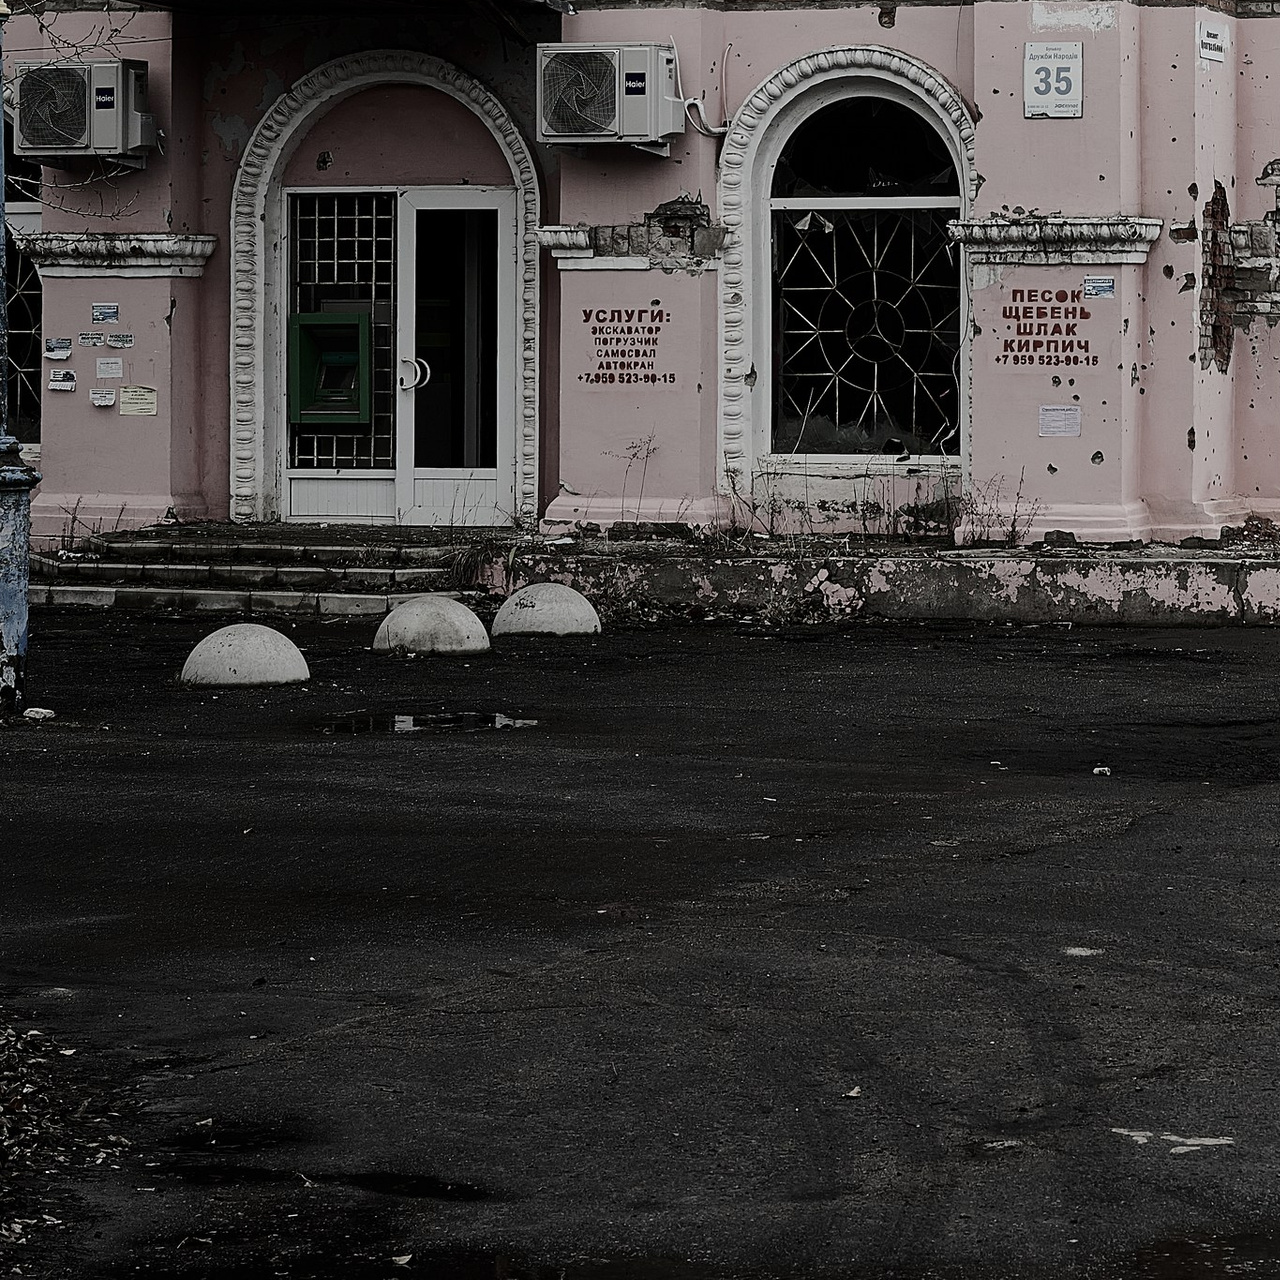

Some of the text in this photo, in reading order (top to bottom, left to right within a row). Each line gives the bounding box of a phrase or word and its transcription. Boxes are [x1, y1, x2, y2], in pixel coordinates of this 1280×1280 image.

[1028, 52, 1078, 61] Дружби Народів
[625, 79, 645, 88] Haier
[1033, 66, 1073, 96] 35
[95, 94, 114, 102] Haier
[1012, 289, 1083, 303] ПЕСОК
[582, 309, 671, 323] УСЛУГИ:
[1002, 306, 1091, 322] ЩЕБЕНЬ
[591, 326, 661, 335] ЭКСКАВАТОР
[1016, 323, 1078, 336] ШЛАК
[594, 337, 658, 346] ПОГРУЗЧИК
[1003, 339, 1089, 353] КИРПИЧ
[596, 348, 656, 358] САМОСВАЛ
[597, 361, 654, 371] АВТОКРАН
[995, 354, 1099, 367] +7 959 523-90-15
[594, 372, 616, 384] 959
[618, 372, 676, 384] 523-90-15
